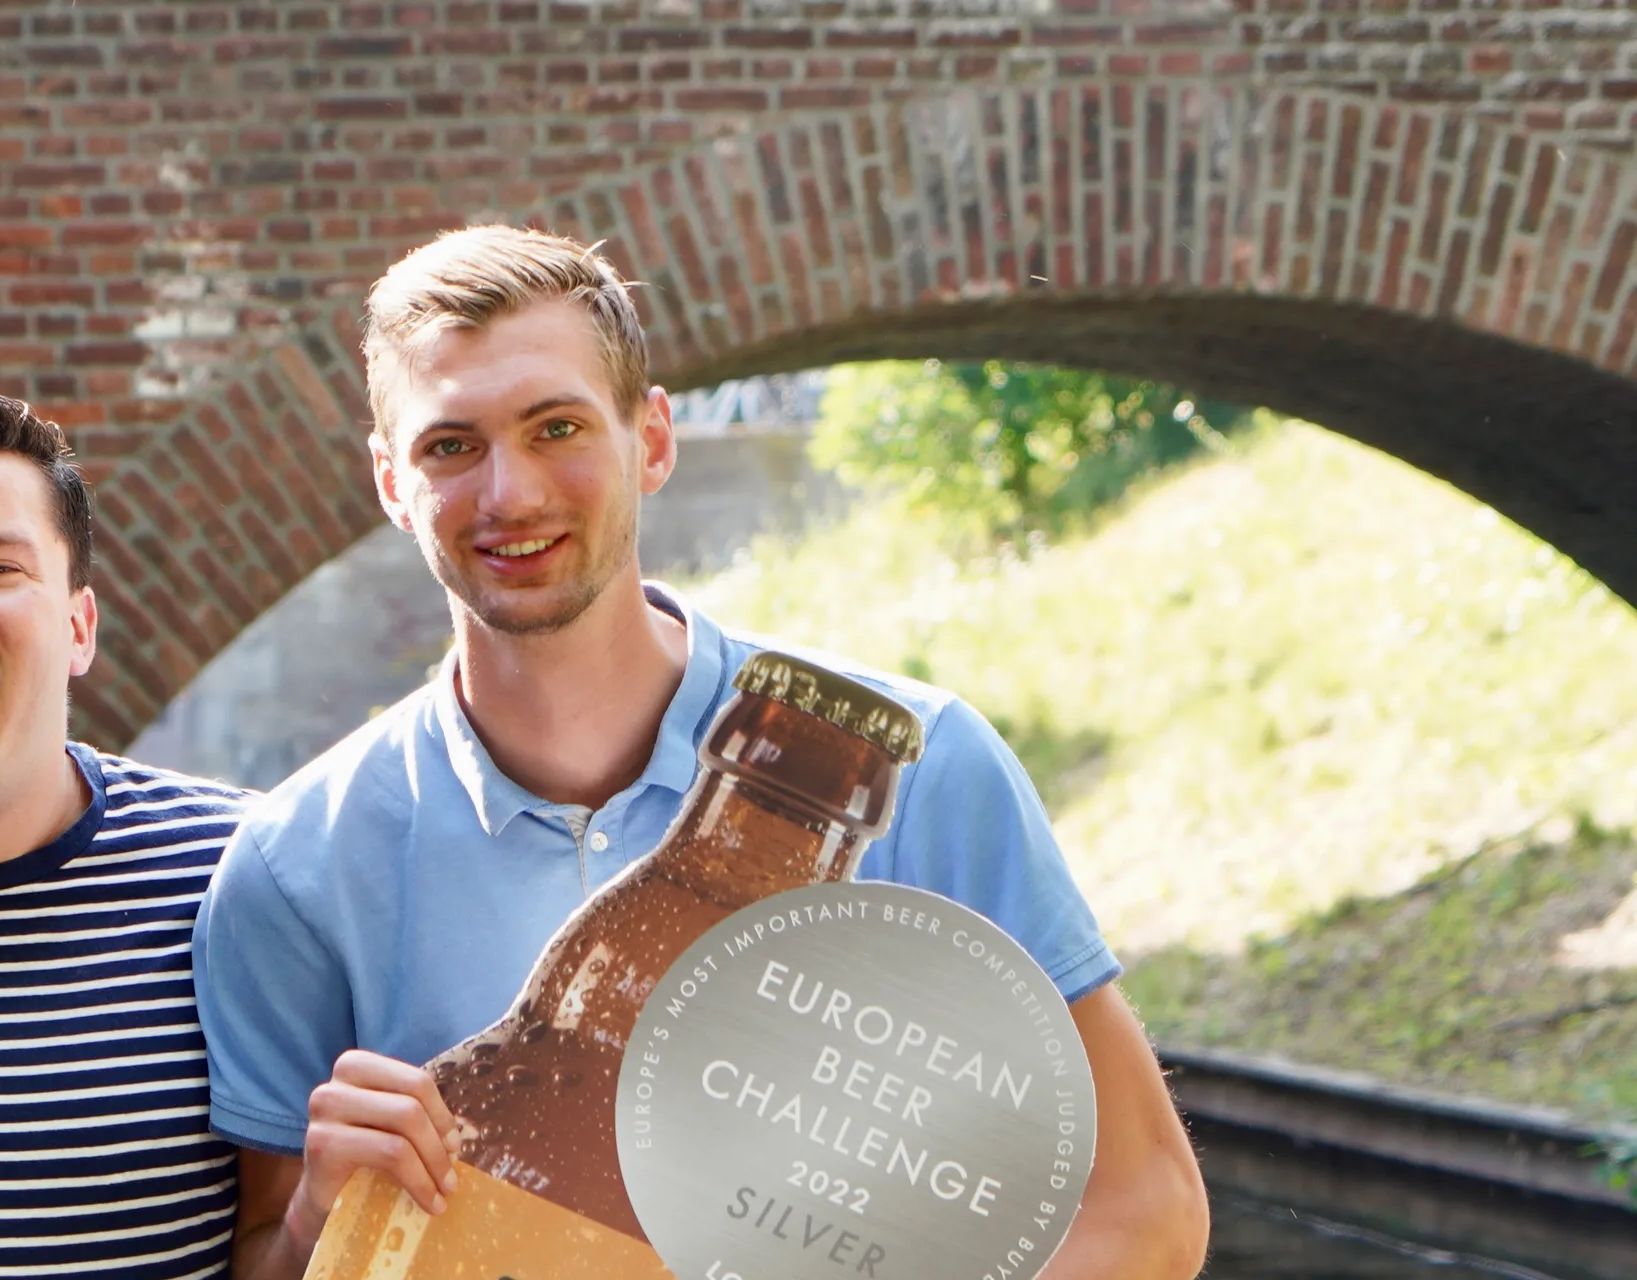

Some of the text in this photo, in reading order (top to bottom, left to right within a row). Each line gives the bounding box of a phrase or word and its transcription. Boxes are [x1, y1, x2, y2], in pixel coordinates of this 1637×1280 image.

[724, 901, 869, 956] IMPORTANT
[883, 905, 941, 935] BEER
[666, 956, 719, 1019] MOST
[952, 930, 1068, 1077] COMPETITION
[756, 959, 1032, 1111] EUROPEAN
[635, 1026, 669, 1149] EUROPE'S
[811, 1045, 933, 1126] BEER
[701, 1060, 1002, 1217] CHALLENGE
[1049, 1091, 1074, 1190] JUDGED
[787, 1161, 870, 1214] 2022
[1034, 1202, 1056, 1231] BY
[727, 1186, 886, 1278] SILVER
